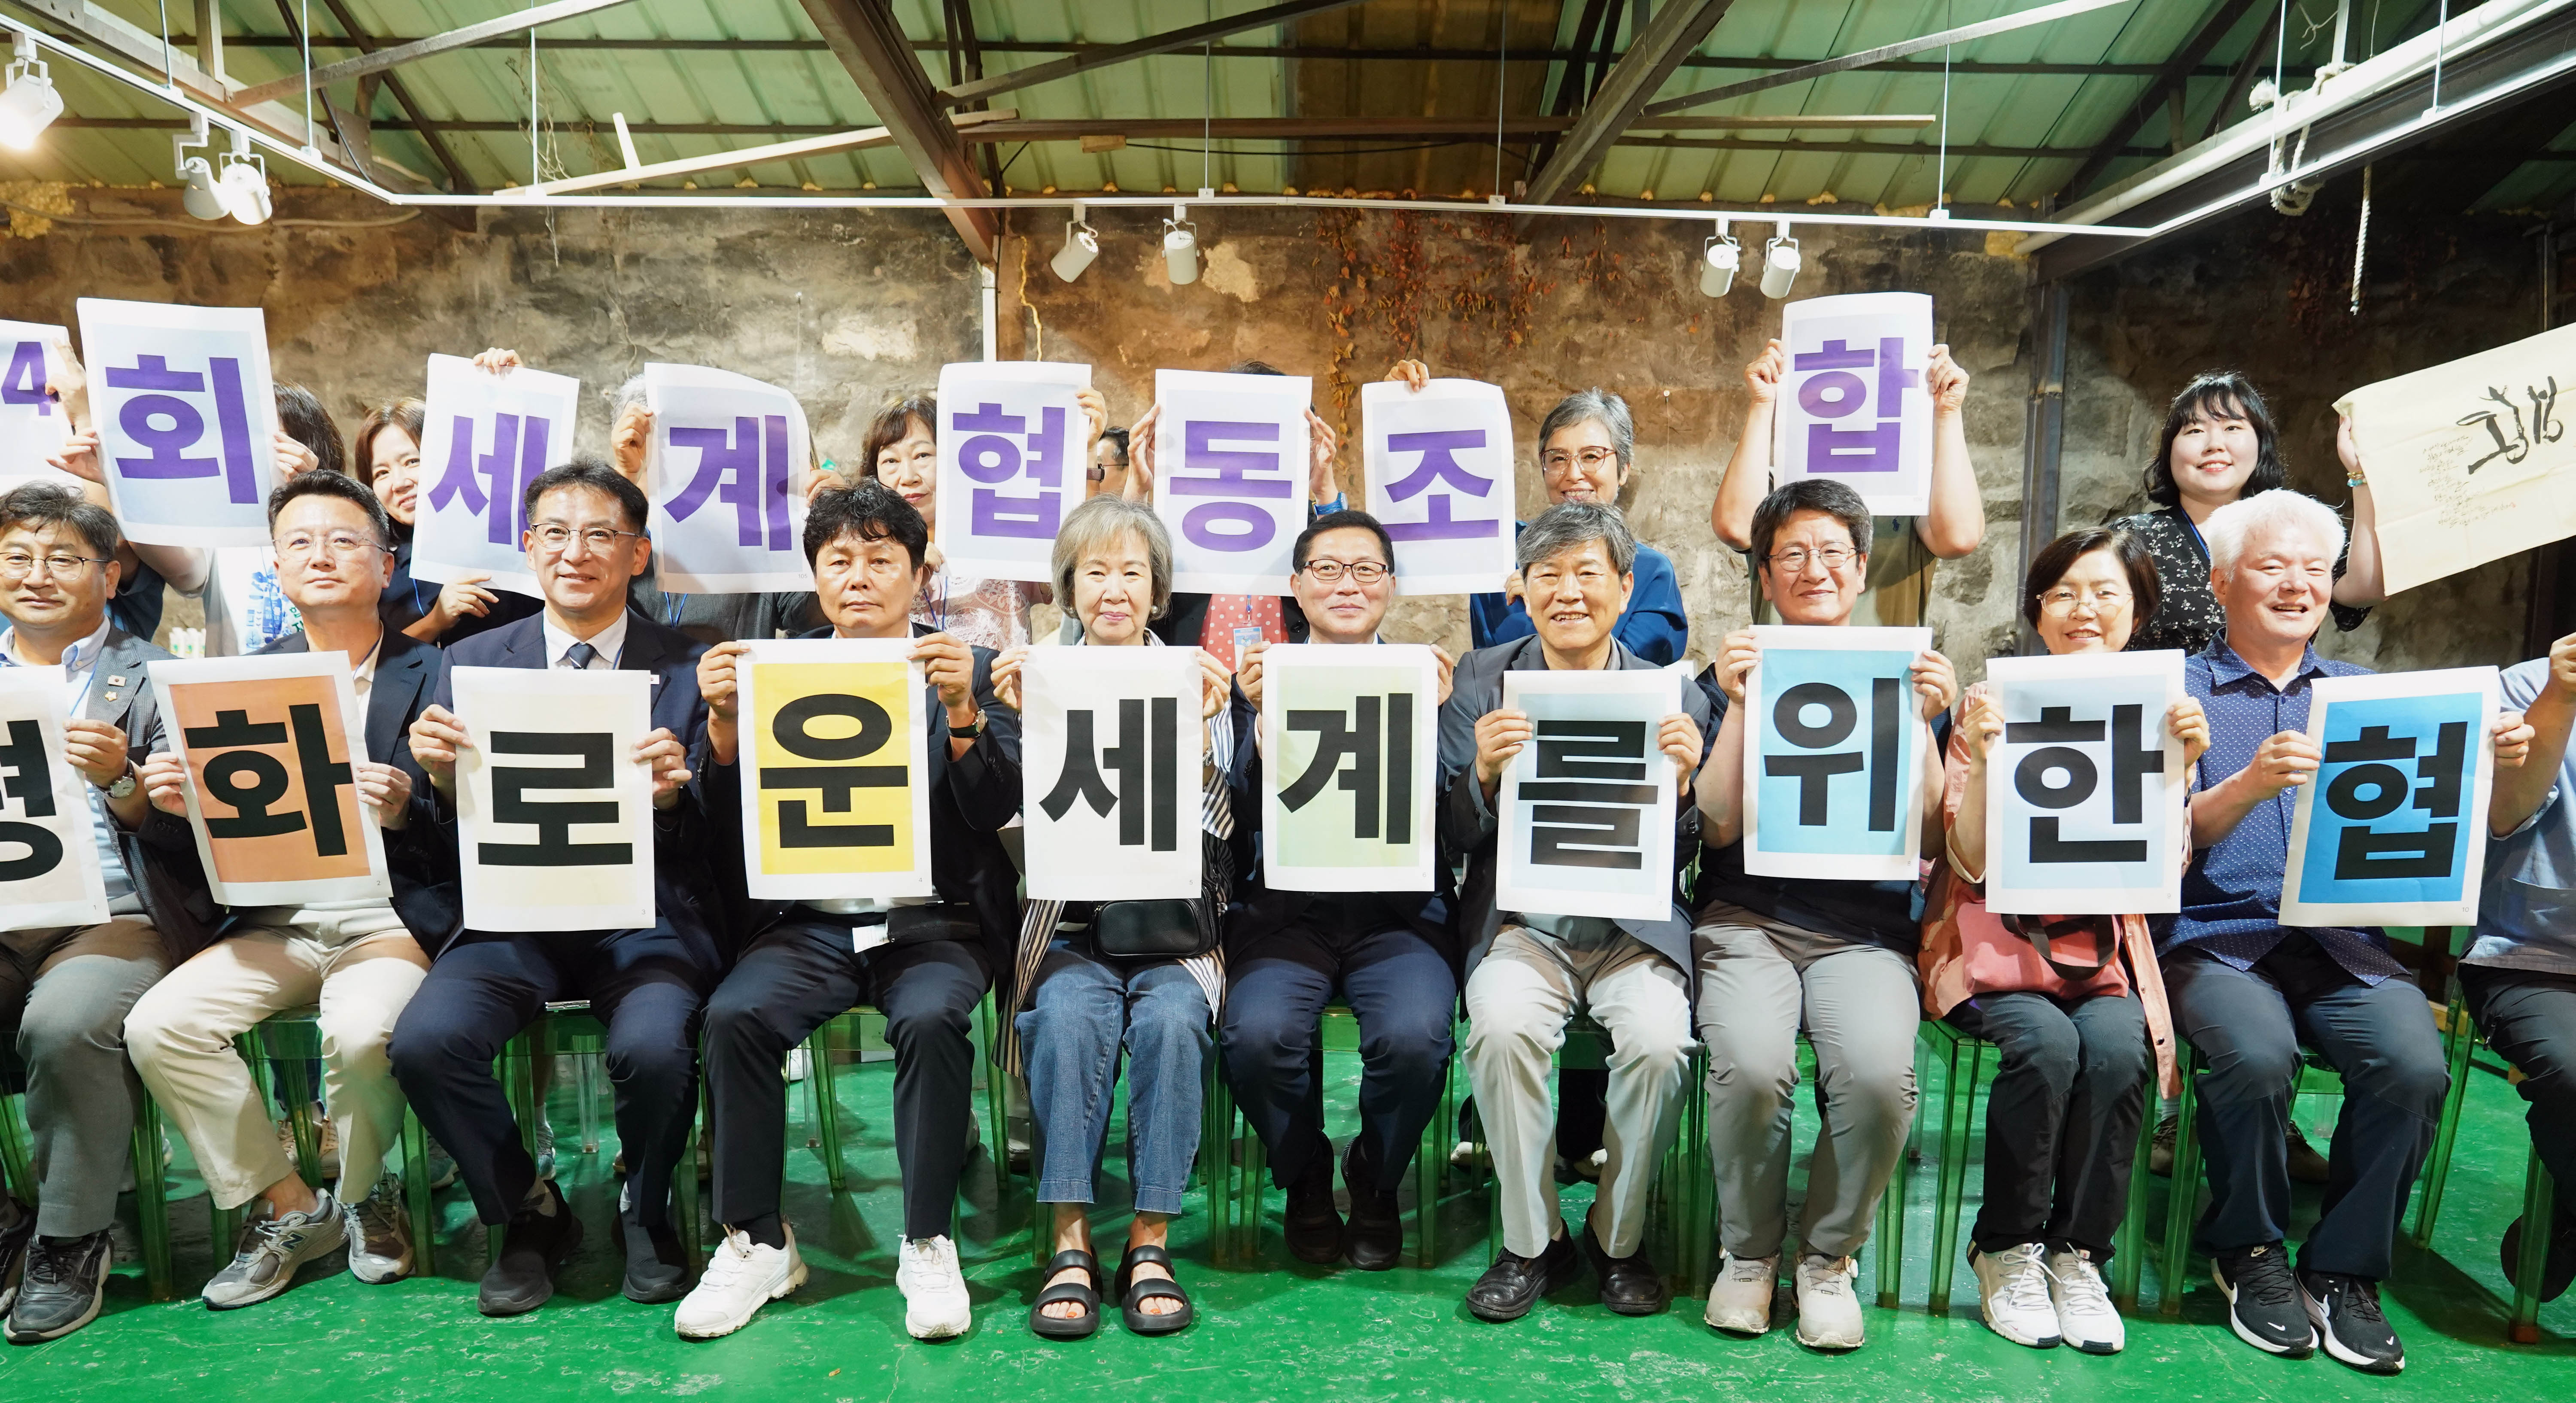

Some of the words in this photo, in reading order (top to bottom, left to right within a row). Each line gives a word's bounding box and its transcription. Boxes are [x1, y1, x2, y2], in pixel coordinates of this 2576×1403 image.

[1, 342, 51, 416] 4
[106, 354, 258, 504] 회
[1795, 337, 1918, 473] 합
[428, 413, 550, 552] 세
[663, 415, 792, 551] 계
[953, 403, 1065, 539] 협
[1170, 420, 1292, 552] 동
[1381, 429, 1499, 543] 조
[184, 703, 354, 857] 화
[478, 731, 633, 866] 로
[759, 694, 908, 848] 운
[1039, 697, 1177, 851] 세
[1277, 693, 1413, 844] 계
[1518, 720, 1658, 869] 를
[1764, 677, 1900, 832] 위
[2005, 704, 2164, 863] 한
[2323, 721, 2468, 881] 협
[278, 1232, 306, 1251] N
